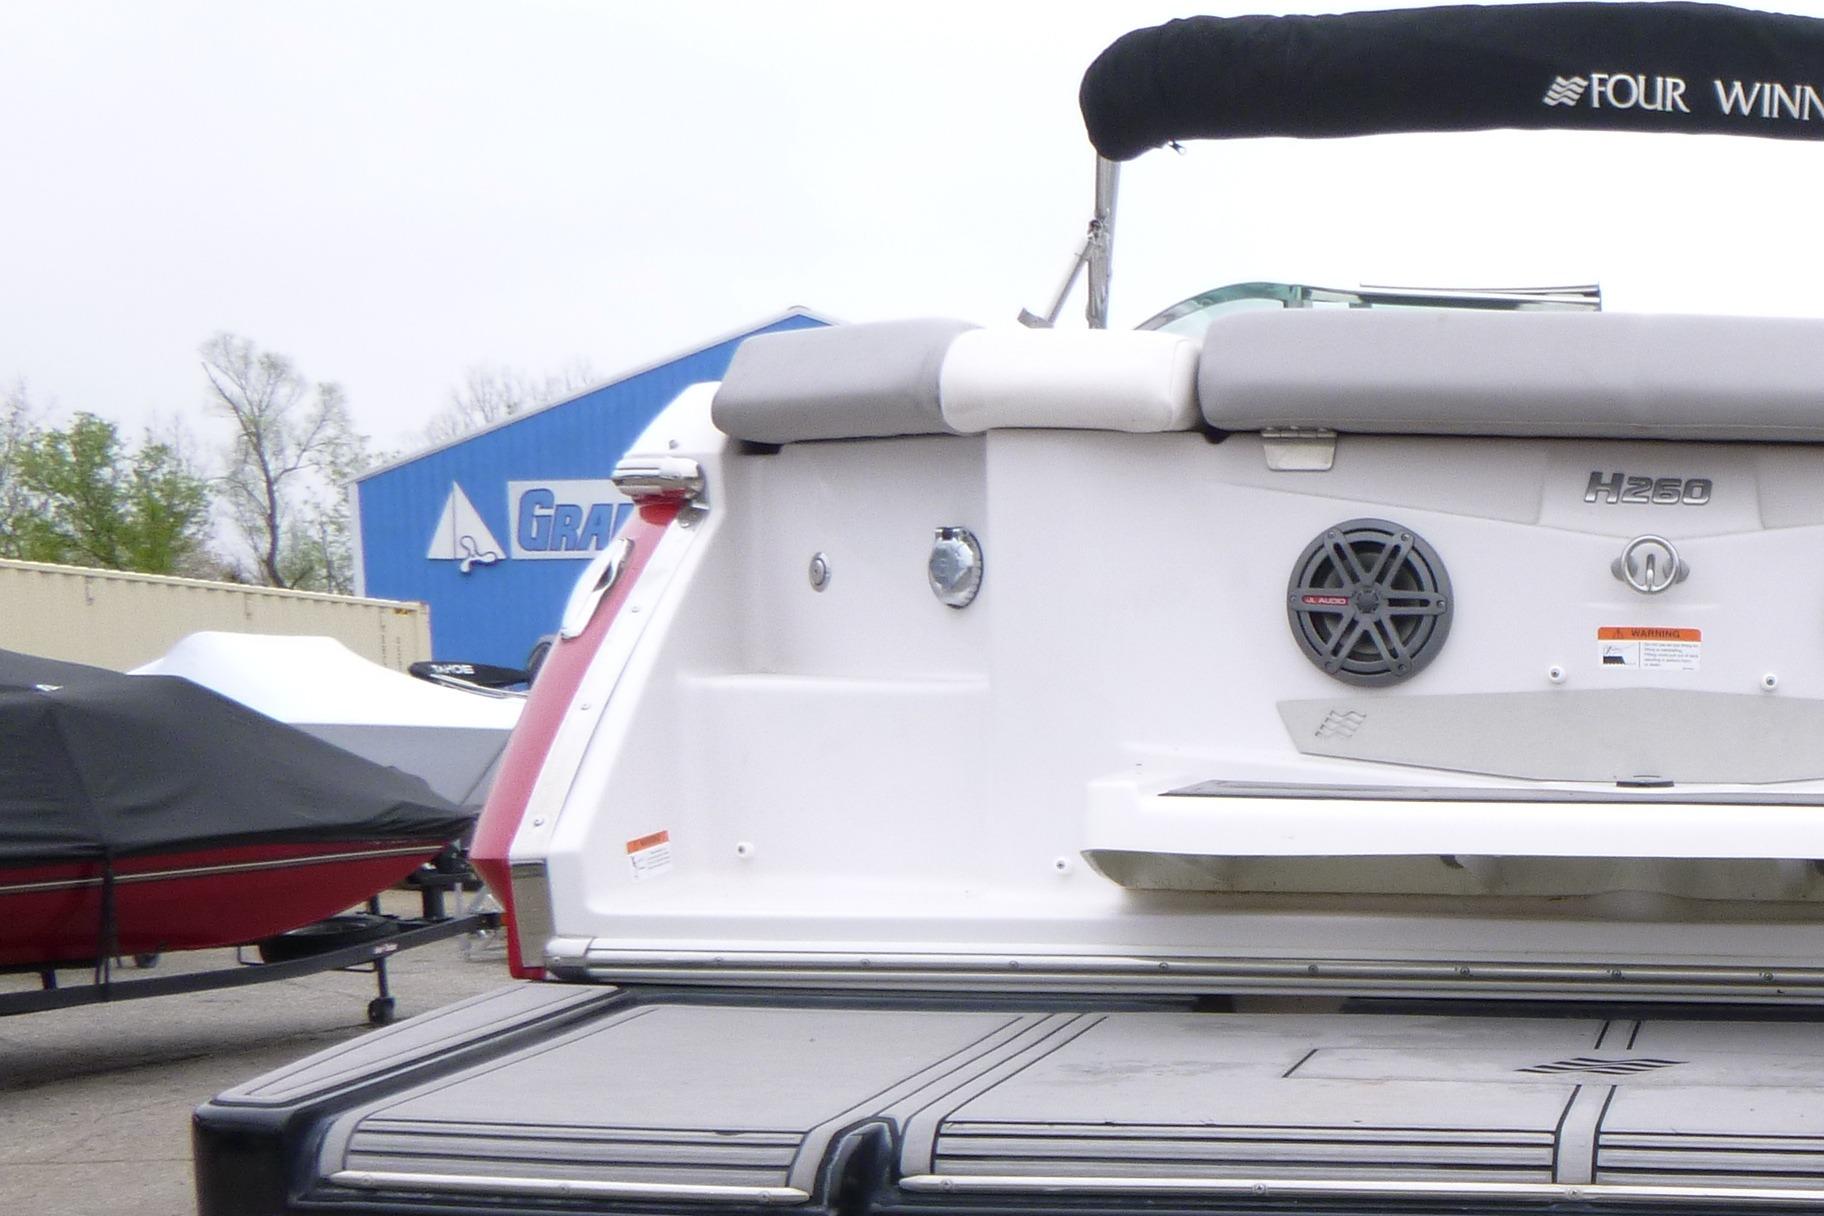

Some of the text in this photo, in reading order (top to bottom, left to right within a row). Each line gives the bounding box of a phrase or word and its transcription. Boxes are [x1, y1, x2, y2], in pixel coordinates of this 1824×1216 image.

[1590, 73, 1690, 113] FOUR
[1584, 471, 1713, 505] H260
[1631, 629, 1680, 638] WARNING
[430, 664, 475, 674] TAHOE
